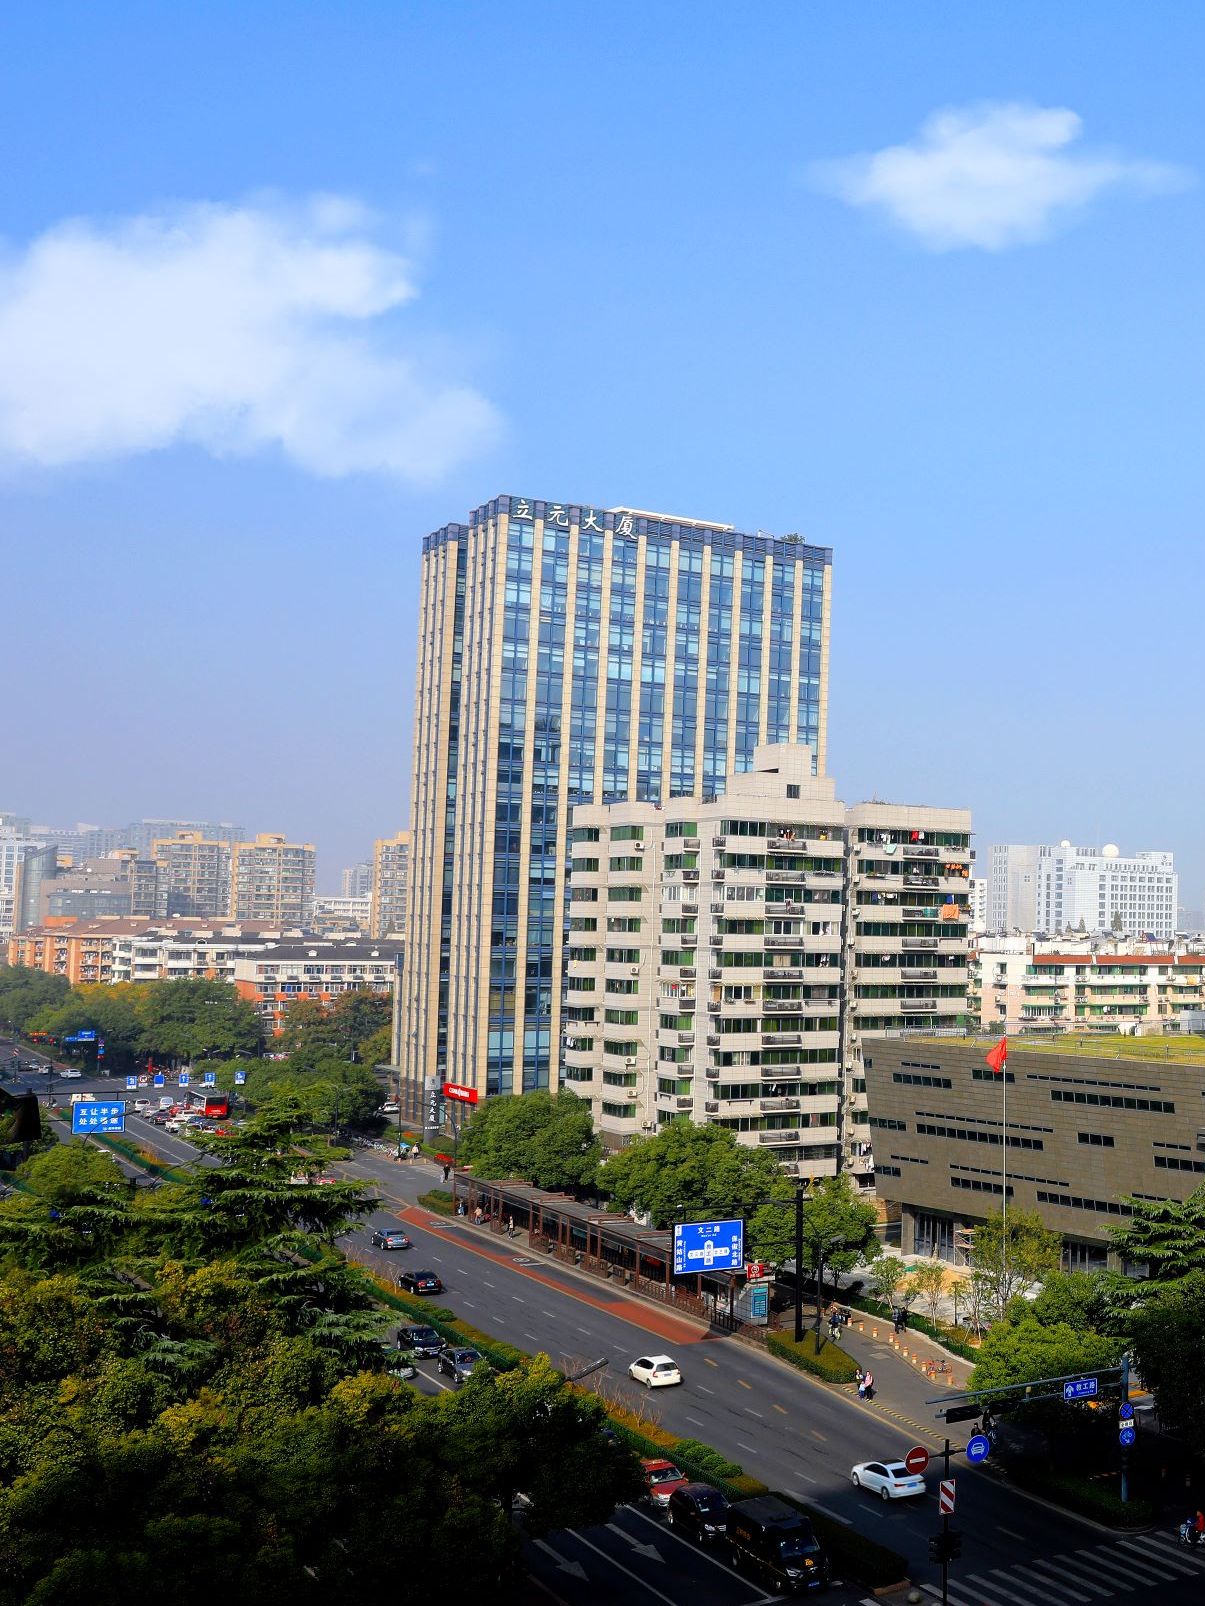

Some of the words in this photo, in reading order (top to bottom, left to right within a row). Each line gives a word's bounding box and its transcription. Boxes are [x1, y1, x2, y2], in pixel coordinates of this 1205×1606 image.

[513, 499, 638, 540] 立元大厦
[429, 1091, 437, 1123] 立元大厦
[697, 1225, 720, 1234] 文二路
